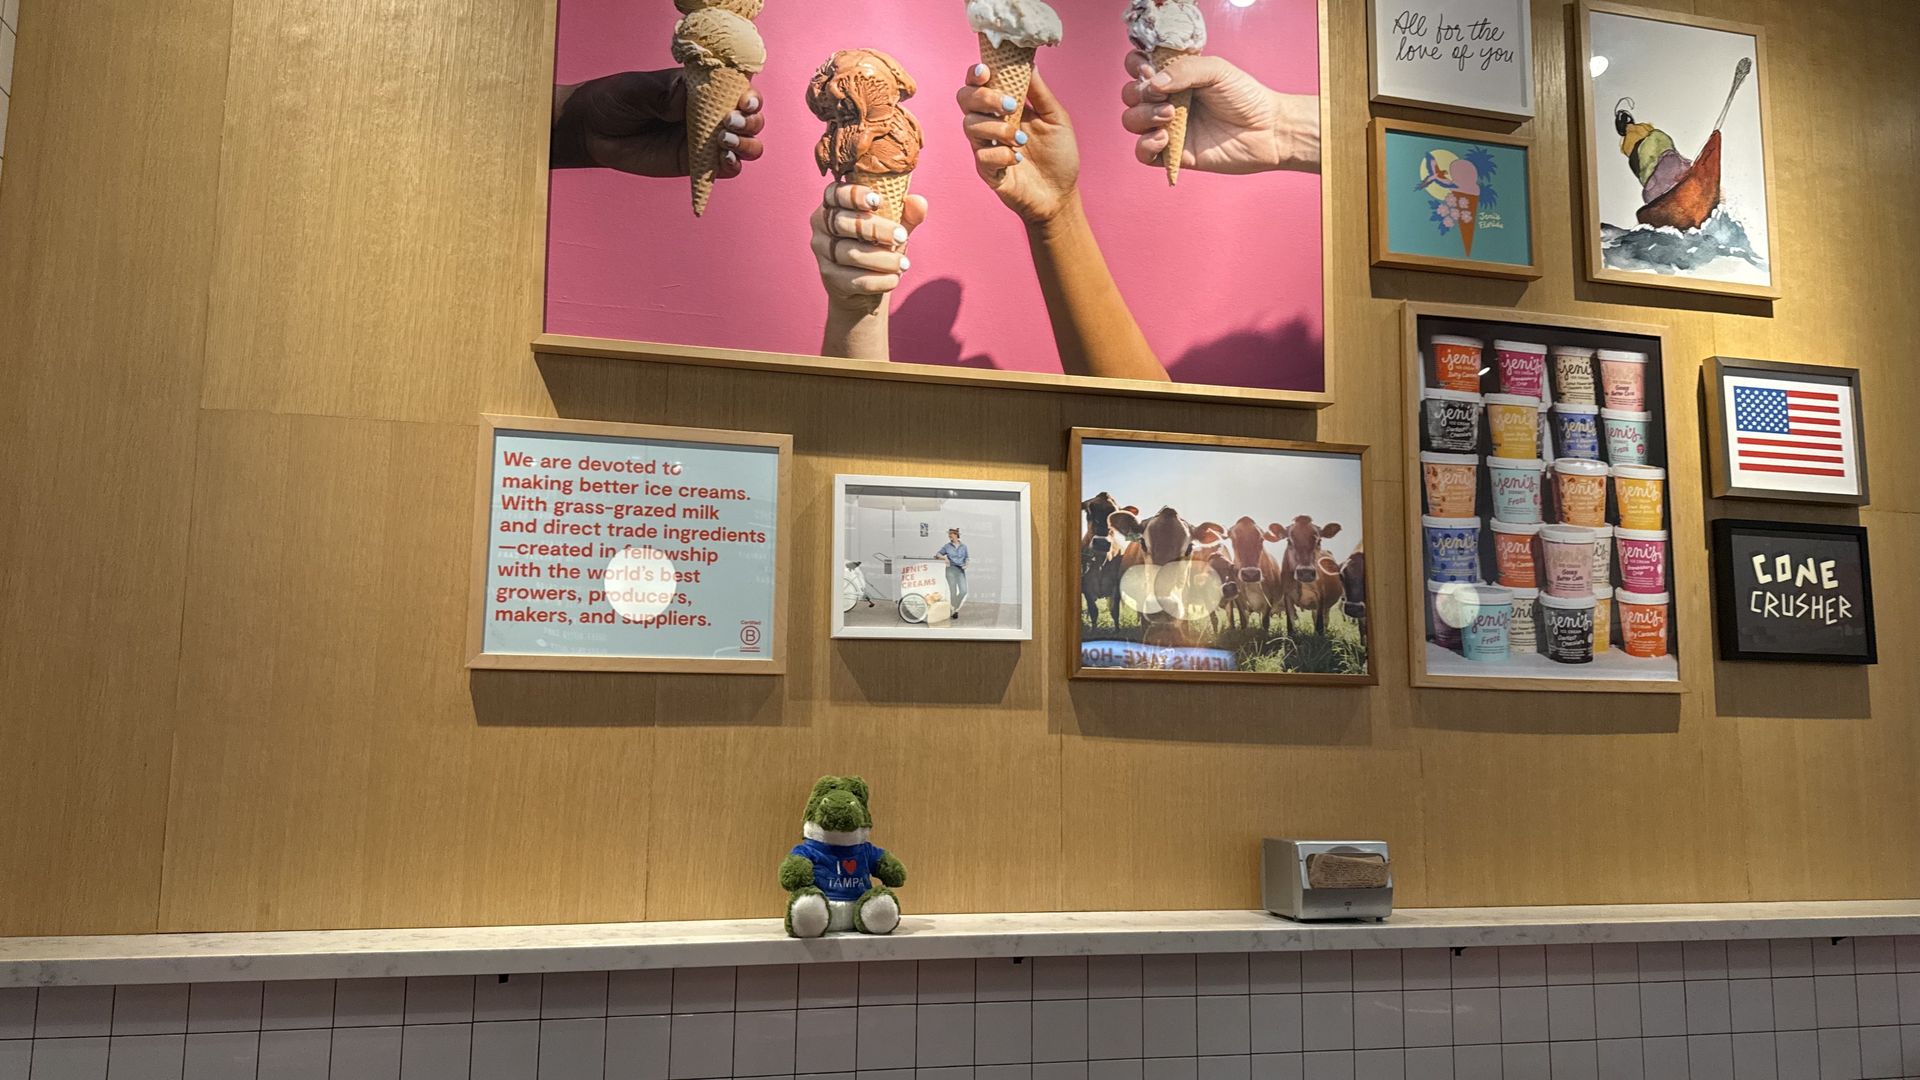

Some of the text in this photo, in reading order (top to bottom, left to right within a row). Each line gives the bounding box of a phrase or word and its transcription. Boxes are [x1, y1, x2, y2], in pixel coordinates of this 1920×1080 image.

[1393, 11, 1505, 44] All for the
[1396, 36, 1514, 71] love of you
[503, 451, 682, 476] We are devoted to
[502, 476, 751, 501] making better ice creams.
[501, 495, 719, 521] With grass-grazed milk
[500, 519, 766, 544] and direct trade ingredients
[600, 543, 617, 558] in
[623, 546, 718, 566] fellowship
[498, 562, 701, 583] with the world's best
[1752, 554, 1839, 590] CONE
[496, 586, 692, 606] growers, producers,
[1751, 591, 1852, 625] CRUSHER
[495, 606, 712, 629] makers, and suppliers.
[745, 629, 756, 642] B
[836, 860, 841, 875] I
[827, 877, 865, 888] TAMPA
